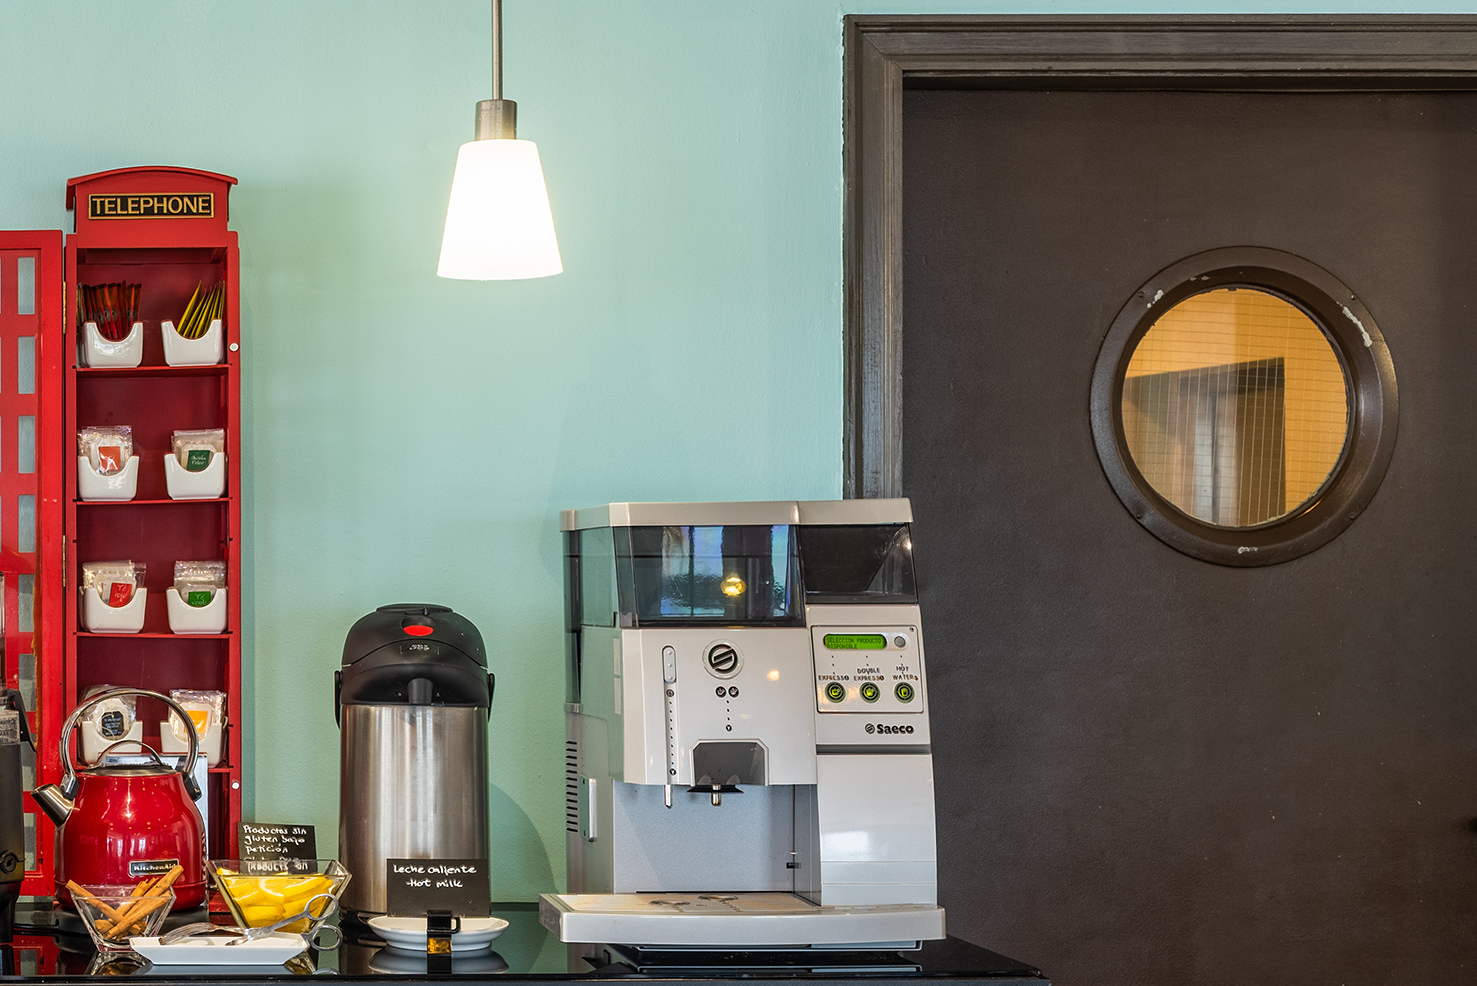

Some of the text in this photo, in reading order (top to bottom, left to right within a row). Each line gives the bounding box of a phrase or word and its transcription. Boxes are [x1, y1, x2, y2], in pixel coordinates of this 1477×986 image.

[92, 196, 210, 214] TELEPHONE
[876, 724, 915, 735] Saeco
[244, 835, 278, 845] gluten
[406, 878, 464, 888] Hot milk
